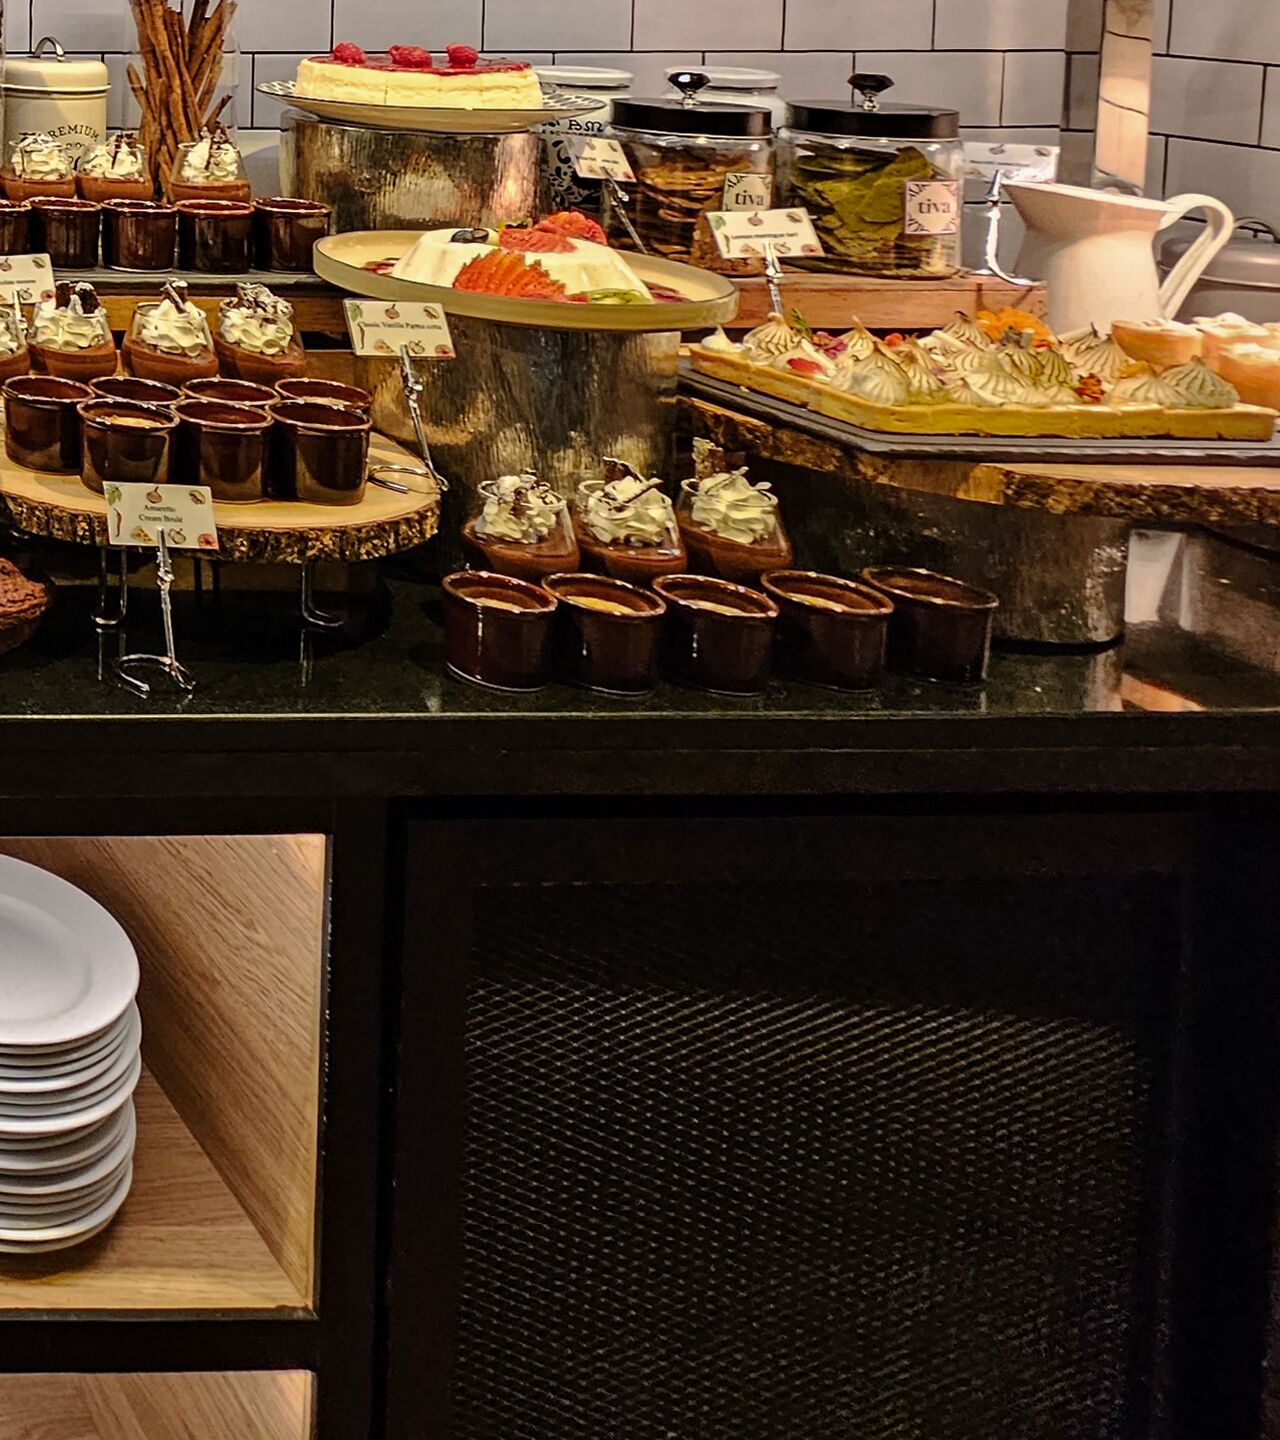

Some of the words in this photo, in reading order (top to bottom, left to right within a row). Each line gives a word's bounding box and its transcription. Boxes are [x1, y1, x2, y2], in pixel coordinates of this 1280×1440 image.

[47, 124, 99, 142] REMIUM
[735, 190, 764, 206] tiva
[918, 198, 950, 214] tiva
